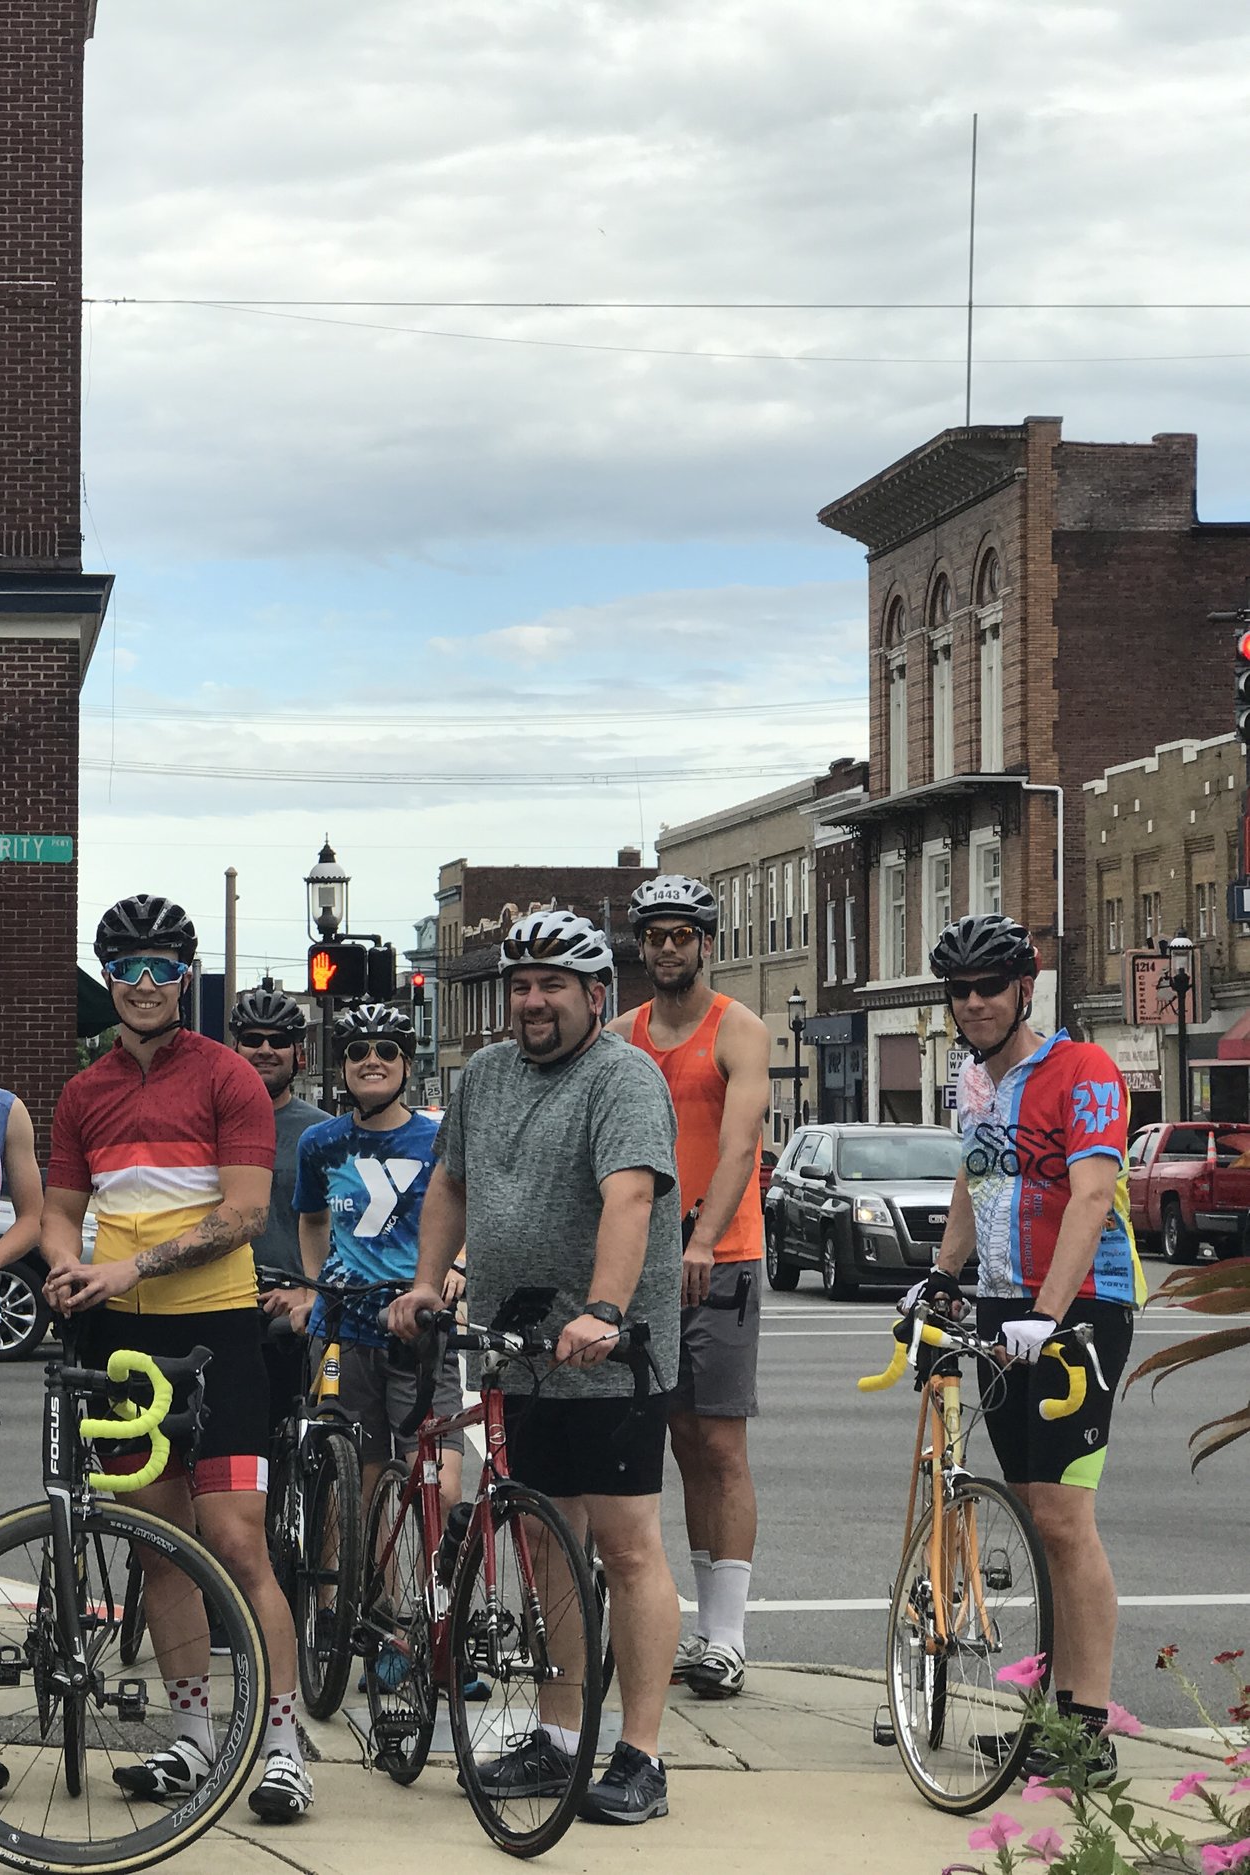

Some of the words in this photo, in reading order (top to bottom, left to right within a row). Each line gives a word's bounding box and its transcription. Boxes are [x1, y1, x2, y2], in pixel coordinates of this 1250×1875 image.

[51, 839, 69, 847] PKWY
[652, 890, 680, 901] 1443
[1135, 962, 1156, 973] 1214
[1138, 975, 1147, 1015] CENTRAL
[950, 1052, 969, 1060] ONE
[950, 1061, 962, 1069] WA
[427, 1087, 441, 1096] 25
[329, 1195, 353, 1212] the
[382, 1214, 399, 1235] YMCA
[51, 1396, 60, 1475] FOCUS
[172, 1653, 249, 1828] REYNOLDS
